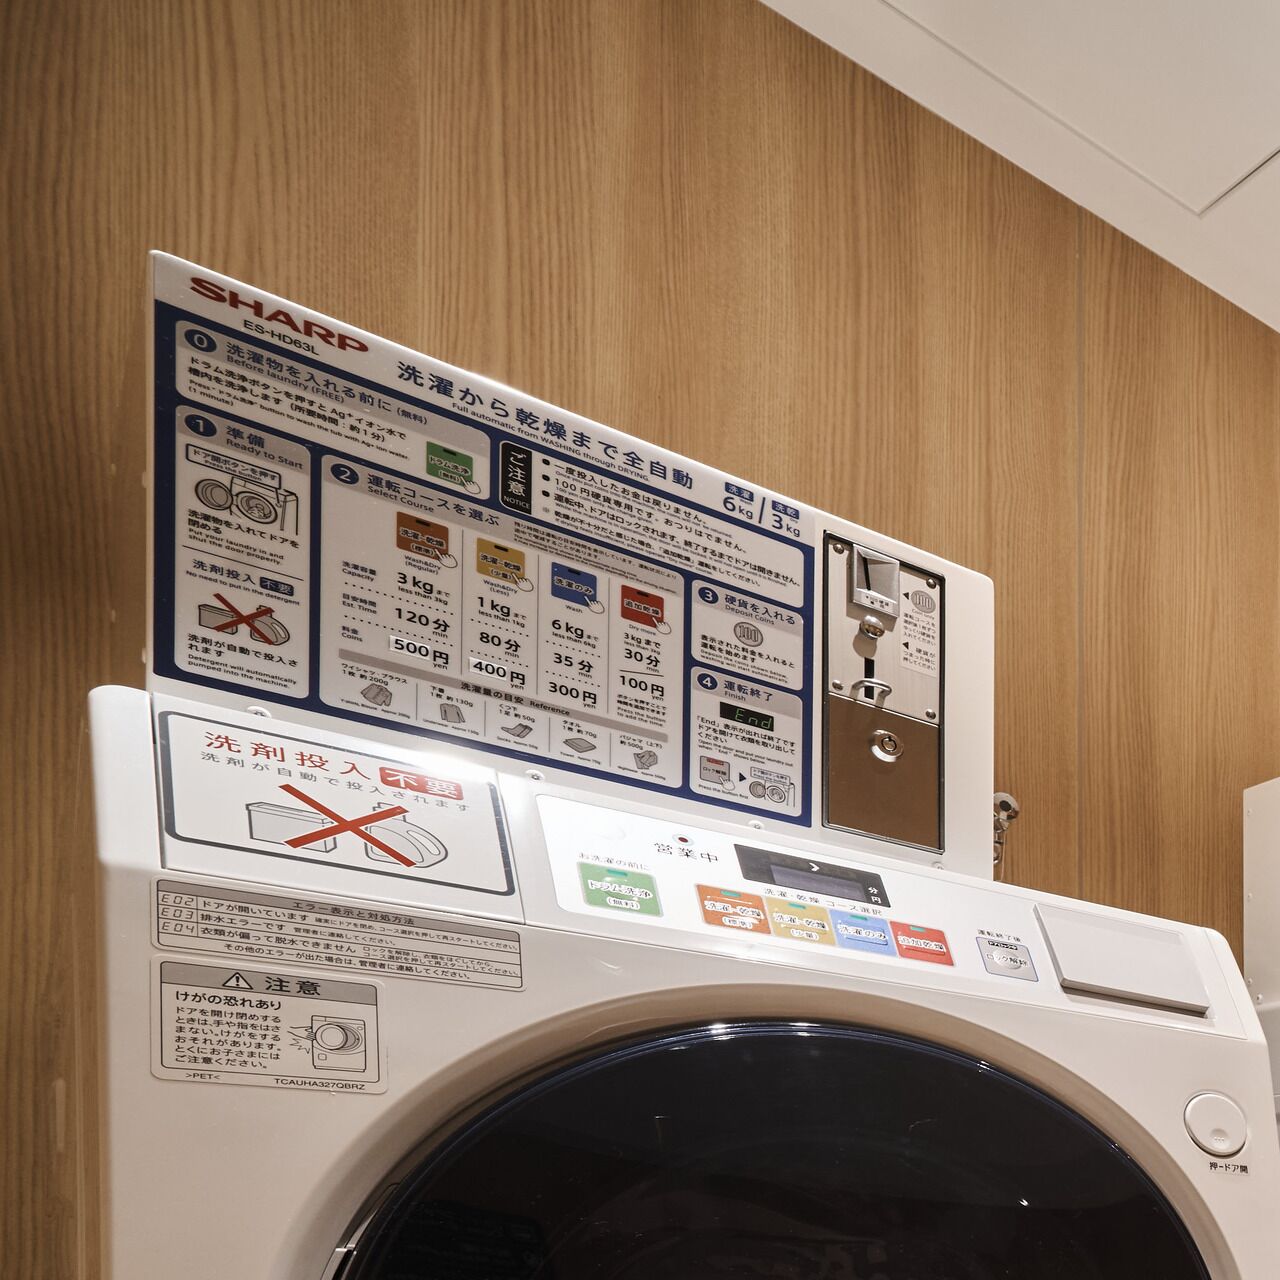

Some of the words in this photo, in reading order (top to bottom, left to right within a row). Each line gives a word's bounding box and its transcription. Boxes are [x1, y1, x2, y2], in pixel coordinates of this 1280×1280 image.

[190, 274, 368, 359] SHARP
[243, 319, 319, 356] ES-HD63L
[189, 356, 324, 412] ドラム洗浄ボタンを押すと
[226, 341, 391, 413] 洗濯物を入れる前に
[227, 354, 263, 375] Before
[267, 368, 309, 392] laundry
[311, 385, 344, 404] (FREE)
[397, 360, 692, 490] 洗濯から乾燥まで全自動
[452, 402, 468, 415] Full
[471, 409, 508, 430] automatic
[510, 423, 538, 440] from
[540, 436, 580, 456] WASHING
[582, 451, 616, 470] through
[226, 425, 264, 449] 準備
[226, 437, 258, 456] Ready
[263, 450, 274, 461] to
[278, 455, 302, 470] Start
[192, 447, 277, 483] ドア開ボタンを押す
[428, 455, 469, 476] ドラム洗浄
[507, 449, 527, 500] ご注意
[367, 485, 395, 501] Select
[399, 495, 433, 513] Course
[367, 473, 498, 527] 運転コースを選ぶ
[504, 496, 530, 510] NOTICE
[554, 462, 707, 525] 一度投入したお金は戻りません。
[728, 484, 751, 500] 洗濯
[188, 517, 222, 536] 閉める
[188, 508, 298, 549] 洗濯物を入れてドアを
[342, 560, 376, 577] 洗濯容量
[404, 554, 440, 572] Wash&Dry
[192, 558, 255, 585] 洗剤投入
[261, 577, 292, 596] 不要
[342, 567, 374, 583] Capacity
[553, 575, 592, 596] 洗濯のみ
[342, 593, 376, 608] 目安時間
[342, 599, 357, 610] Est.
[359, 604, 377, 615] Time
[624, 598, 660, 617] 追加乾燥
[725, 594, 795, 626] 硬貨を入れる
[725, 604, 753, 619] Deposit
[755, 614, 774, 626] Coins
[341, 625, 358, 635] 料金
[341, 631, 362, 642] Coins
[188, 632, 297, 668] 洗剤が自動で投入さ
[188, 642, 223, 659] れます
[394, 638, 428, 658] 500
[433, 649, 449, 665] 円
[700, 634, 794, 669] 表示された料金を入れると
[700, 641, 755, 664] 運転を始めます
[473, 660, 506, 679] 400
[510, 670, 525, 685] 円
[460, 681, 524, 705] 洗濯量の目安
[530, 700, 569, 716] Reference
[723, 679, 773, 703] 運転終了
[724, 690, 746, 702] Finish
[735, 707, 772, 730] End
[697, 723, 794, 755] ドアを開けて衣類を取り出して
[203, 731, 371, 781] 洗剤投入
[386, 769, 458, 798] 不要
[200, 751, 470, 812] 洗剤が自動で投入されます
[579, 852, 651, 872] お洗濯の前に
[653, 841, 719, 864] 営業中
[587, 880, 652, 899] ドラム洗浄
[161, 907, 195, 921] E03
[201, 912, 286, 931] 排水エラーです
[202, 900, 309, 922] ドアが開いています
[292, 901, 415, 926] エラー表示と対処方法
[161, 921, 195, 934] E04
[201, 928, 356, 954] 衣類が偏って脱水できません
[837, 923, 887, 942] 洗濯のみ
[977, 929, 1022, 943] 運転終了後
[899, 935, 947, 953] 追加乾燥
[986, 954, 1028, 969] ロック解除
[264, 976, 321, 996] 注意
[175, 991, 282, 1010] けがの恐れあり
[175, 1006, 281, 1023] ドアを開け閉めする
[175, 1017, 281, 1032] ときは、手や指をはさ
[175, 1026, 281, 1041] まない。けがをする
[175, 1036, 282, 1051] おそれがあります。
[175, 1046, 280, 1061] とくにお子さまには
[175, 1054, 268, 1069] ご注意ください。
[185, 1072, 220, 1081] >PET<
